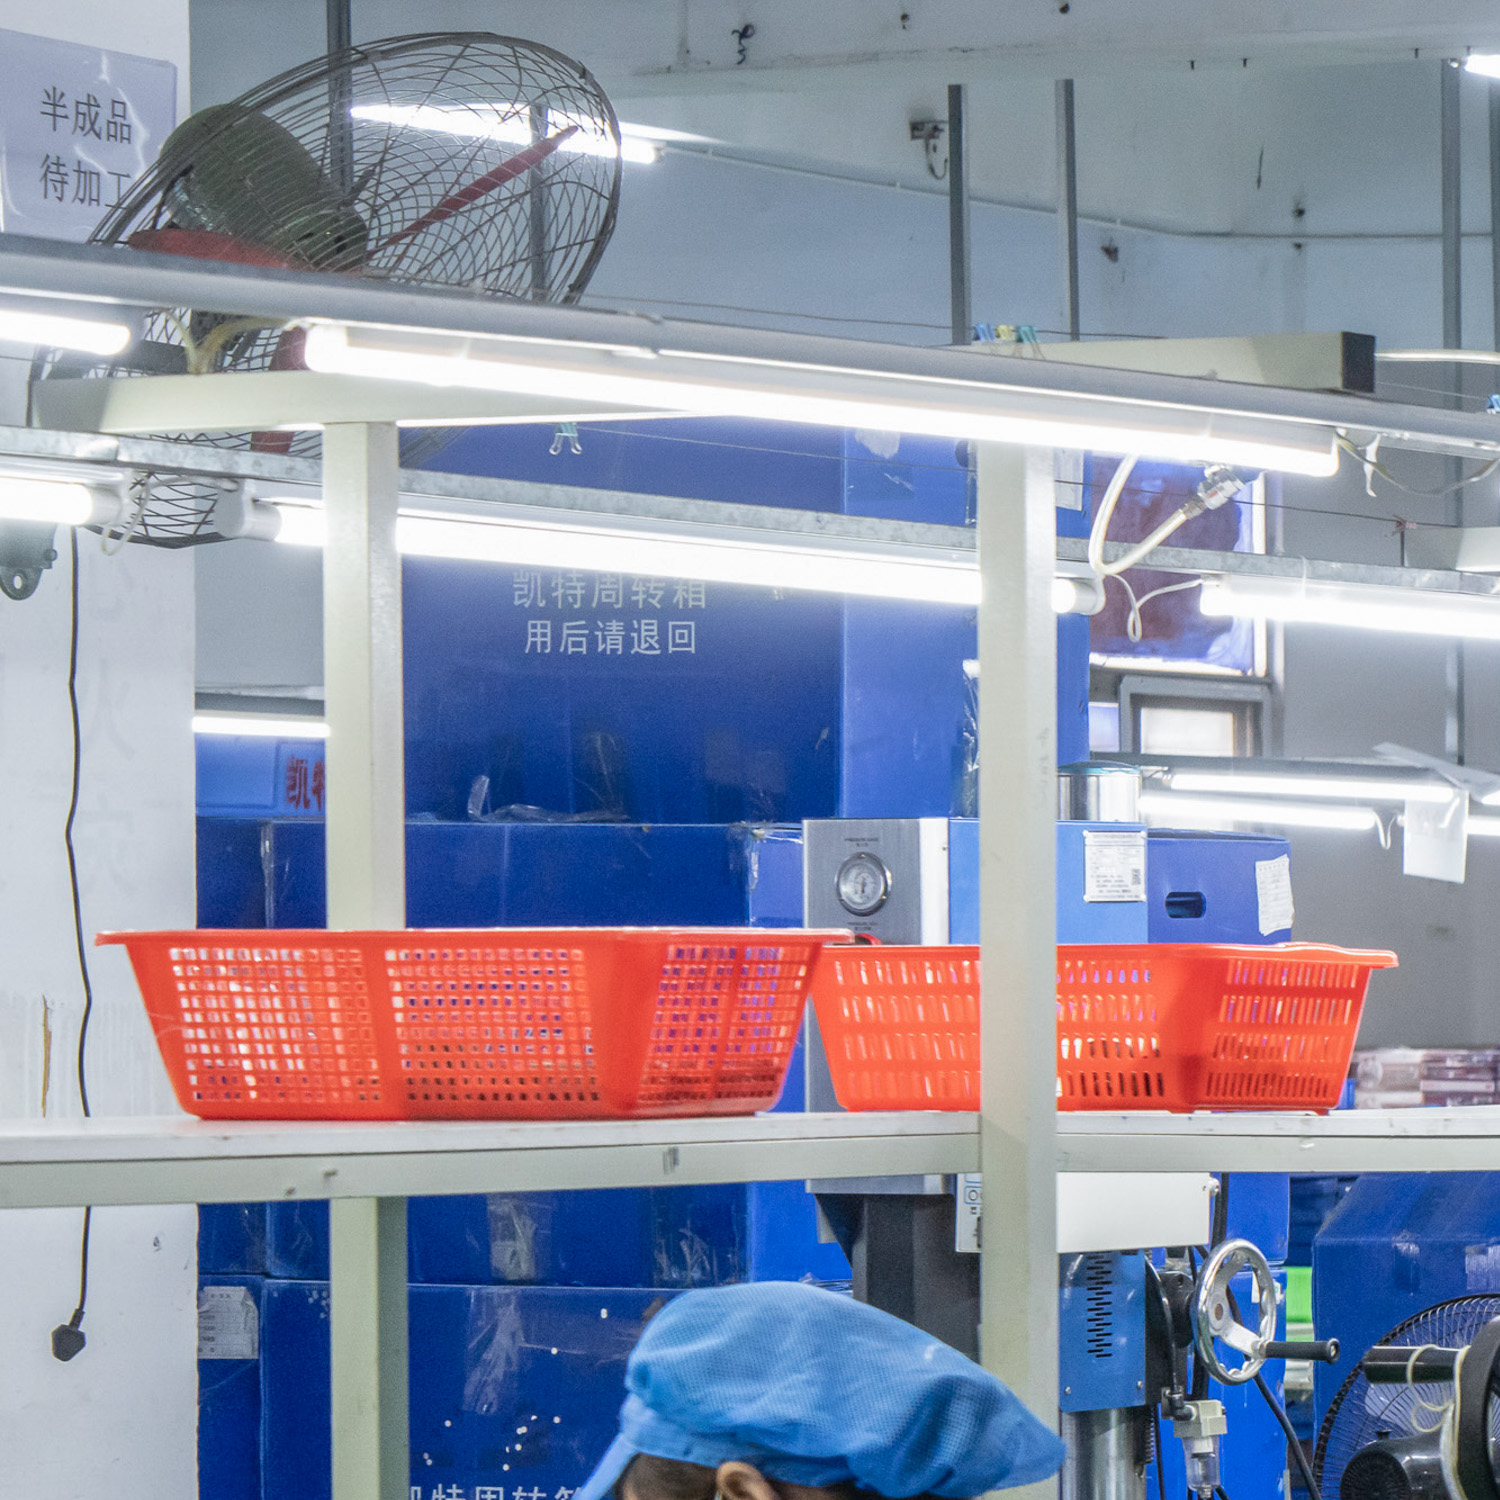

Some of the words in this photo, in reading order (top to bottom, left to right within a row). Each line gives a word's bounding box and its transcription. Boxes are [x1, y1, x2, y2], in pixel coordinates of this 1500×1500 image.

[40, 85, 132, 145] 半成品
[39, 153, 132, 210] 待加工
[511, 569, 707, 610] 凯特周转箱
[524, 619, 697, 656] 用后请退回
